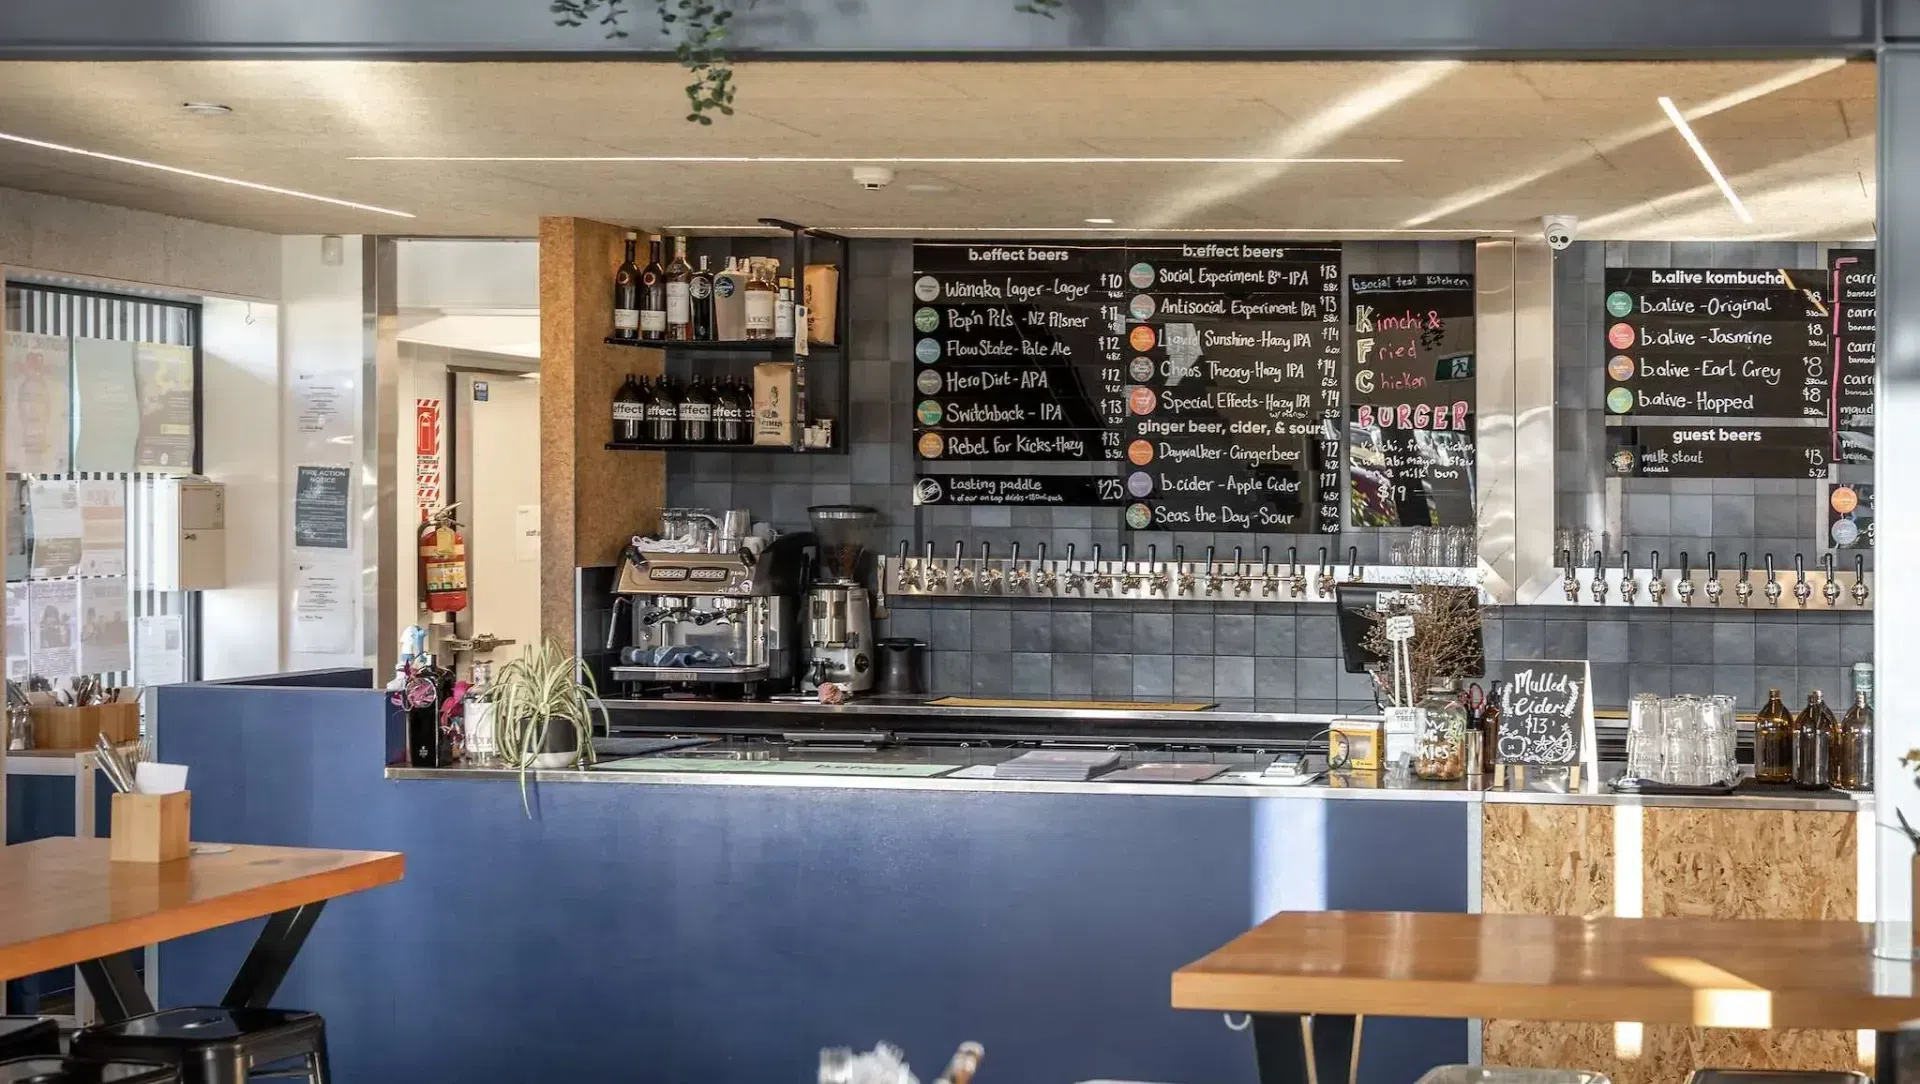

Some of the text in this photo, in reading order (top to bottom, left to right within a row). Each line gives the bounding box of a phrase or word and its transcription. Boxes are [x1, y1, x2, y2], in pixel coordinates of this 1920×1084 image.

[969, 249, 1068, 261] b.effect beers
[1183, 245, 1283, 258] b.effect beers
[1160, 268, 1194, 284] Social
[1199, 268, 1264, 287] Experiment
[1320, 265, 1337, 280] $13
[1652, 271, 1786, 285] b.alive kombucha
[1100, 274, 1123, 288] $10
[1395, 276, 1417, 286] test
[1101, 305, 1118, 320] $11
[1161, 298, 1316, 319] Antisocial Experiment IPA
[1320, 296, 1337, 313] $13
[1640, 296, 1695, 314] b.alive
[988, 309, 1014, 326] Pils
[1050, 312, 1089, 327] Pilsner
[1428, 310, 1440, 329] &
[1321, 326, 1339, 341] $14
[1640, 327, 1695, 346] b.alive
[1807, 324, 1823, 336] $8
[1099, 336, 1120, 350] $12
[1293, 333, 1311, 347] IPA
[1051, 341, 1071, 356] Ale
[1102, 368, 1120, 381] $12
[1160, 361, 1202, 377] Chaos
[1286, 363, 1304, 378] IPA
[1317, 359, 1335, 378] $14
[1640, 357, 1690, 377] b.alive
[1742, 360, 1781, 385] Grey
[1803, 356, 1823, 377] $8
[1161, 391, 1214, 413] Special
[1296, 394, 1310, 408] IPA
[1321, 390, 1340, 407] $14
[1697, 391, 1753, 414] Hopped
[1803, 387, 1821, 403] $8
[946, 403, 1062, 423] Switchback IPA
[1101, 399, 1122, 414] $13
[1358, 401, 1468, 431] BURGER
[1138, 420, 1185, 435] ginger
[1189, 420, 1226, 435] beer,
[1230, 420, 1271, 436] cider,
[1275, 422, 1286, 434] &
[949, 437, 989, 454] Rebel
[993, 435, 1011, 453] for
[1102, 432, 1119, 446] $13
[1673, 429, 1762, 445] guest beers
[1320, 442, 1338, 458] $12
[1642, 450, 1704, 464] milk stout
[1804, 449, 1823, 465] $13
[1407, 456, 1436, 469] mayo
[1320, 473, 1336, 488] $11
[1434, 469, 1458, 479] bun
[950, 478, 1042, 494] tasting paddle
[1098, 479, 1124, 500] $25
[1161, 473, 1301, 494] b.cider Apple Cider
[1377, 485, 1406, 502] $19
[1155, 502, 1294, 528] Seas the Day Sour
[1321, 507, 1339, 518] $12
[1515, 669, 1568, 695] Mulled
[1525, 714, 1548, 736] $13
